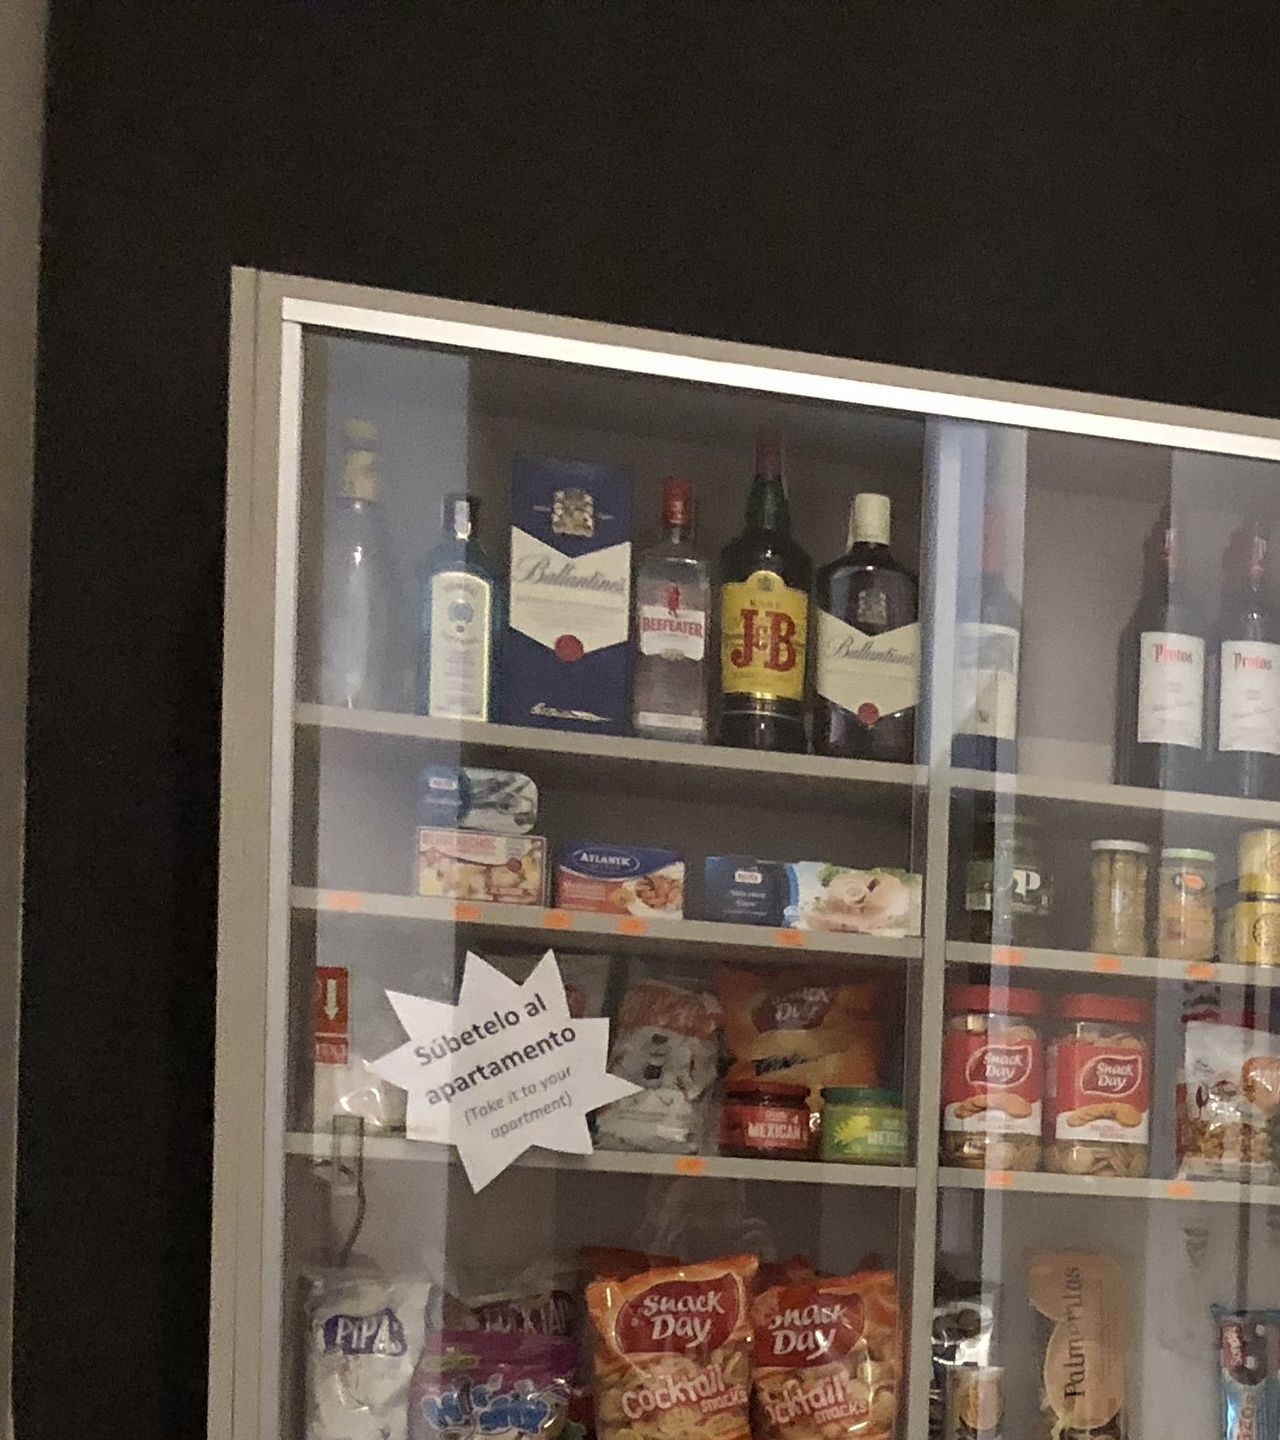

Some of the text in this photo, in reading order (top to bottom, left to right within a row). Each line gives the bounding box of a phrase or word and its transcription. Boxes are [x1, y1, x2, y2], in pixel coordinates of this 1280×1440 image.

[642, 616, 703, 639] BEEFEATER
[1152, 643, 1194, 664] Protos
[1233, 652, 1273, 672] Protos
[414, 992, 547, 1066] Súbetelo al
[425, 1026, 577, 1106] apartamento
[1096, 1061, 1134, 1077] Snack
[464, 1097, 505, 1126] (Take
[522, 1083, 537, 1098] to
[540, 1066, 572, 1092] your
[1097, 1075, 1127, 1092] Day
[490, 1090, 573, 1139] apartment)
[642, 1290, 725, 1316] Snack
[651, 1314, 712, 1348] Day
[772, 1327, 836, 1361] Day
[620, 1363, 726, 1419] Cocktail
